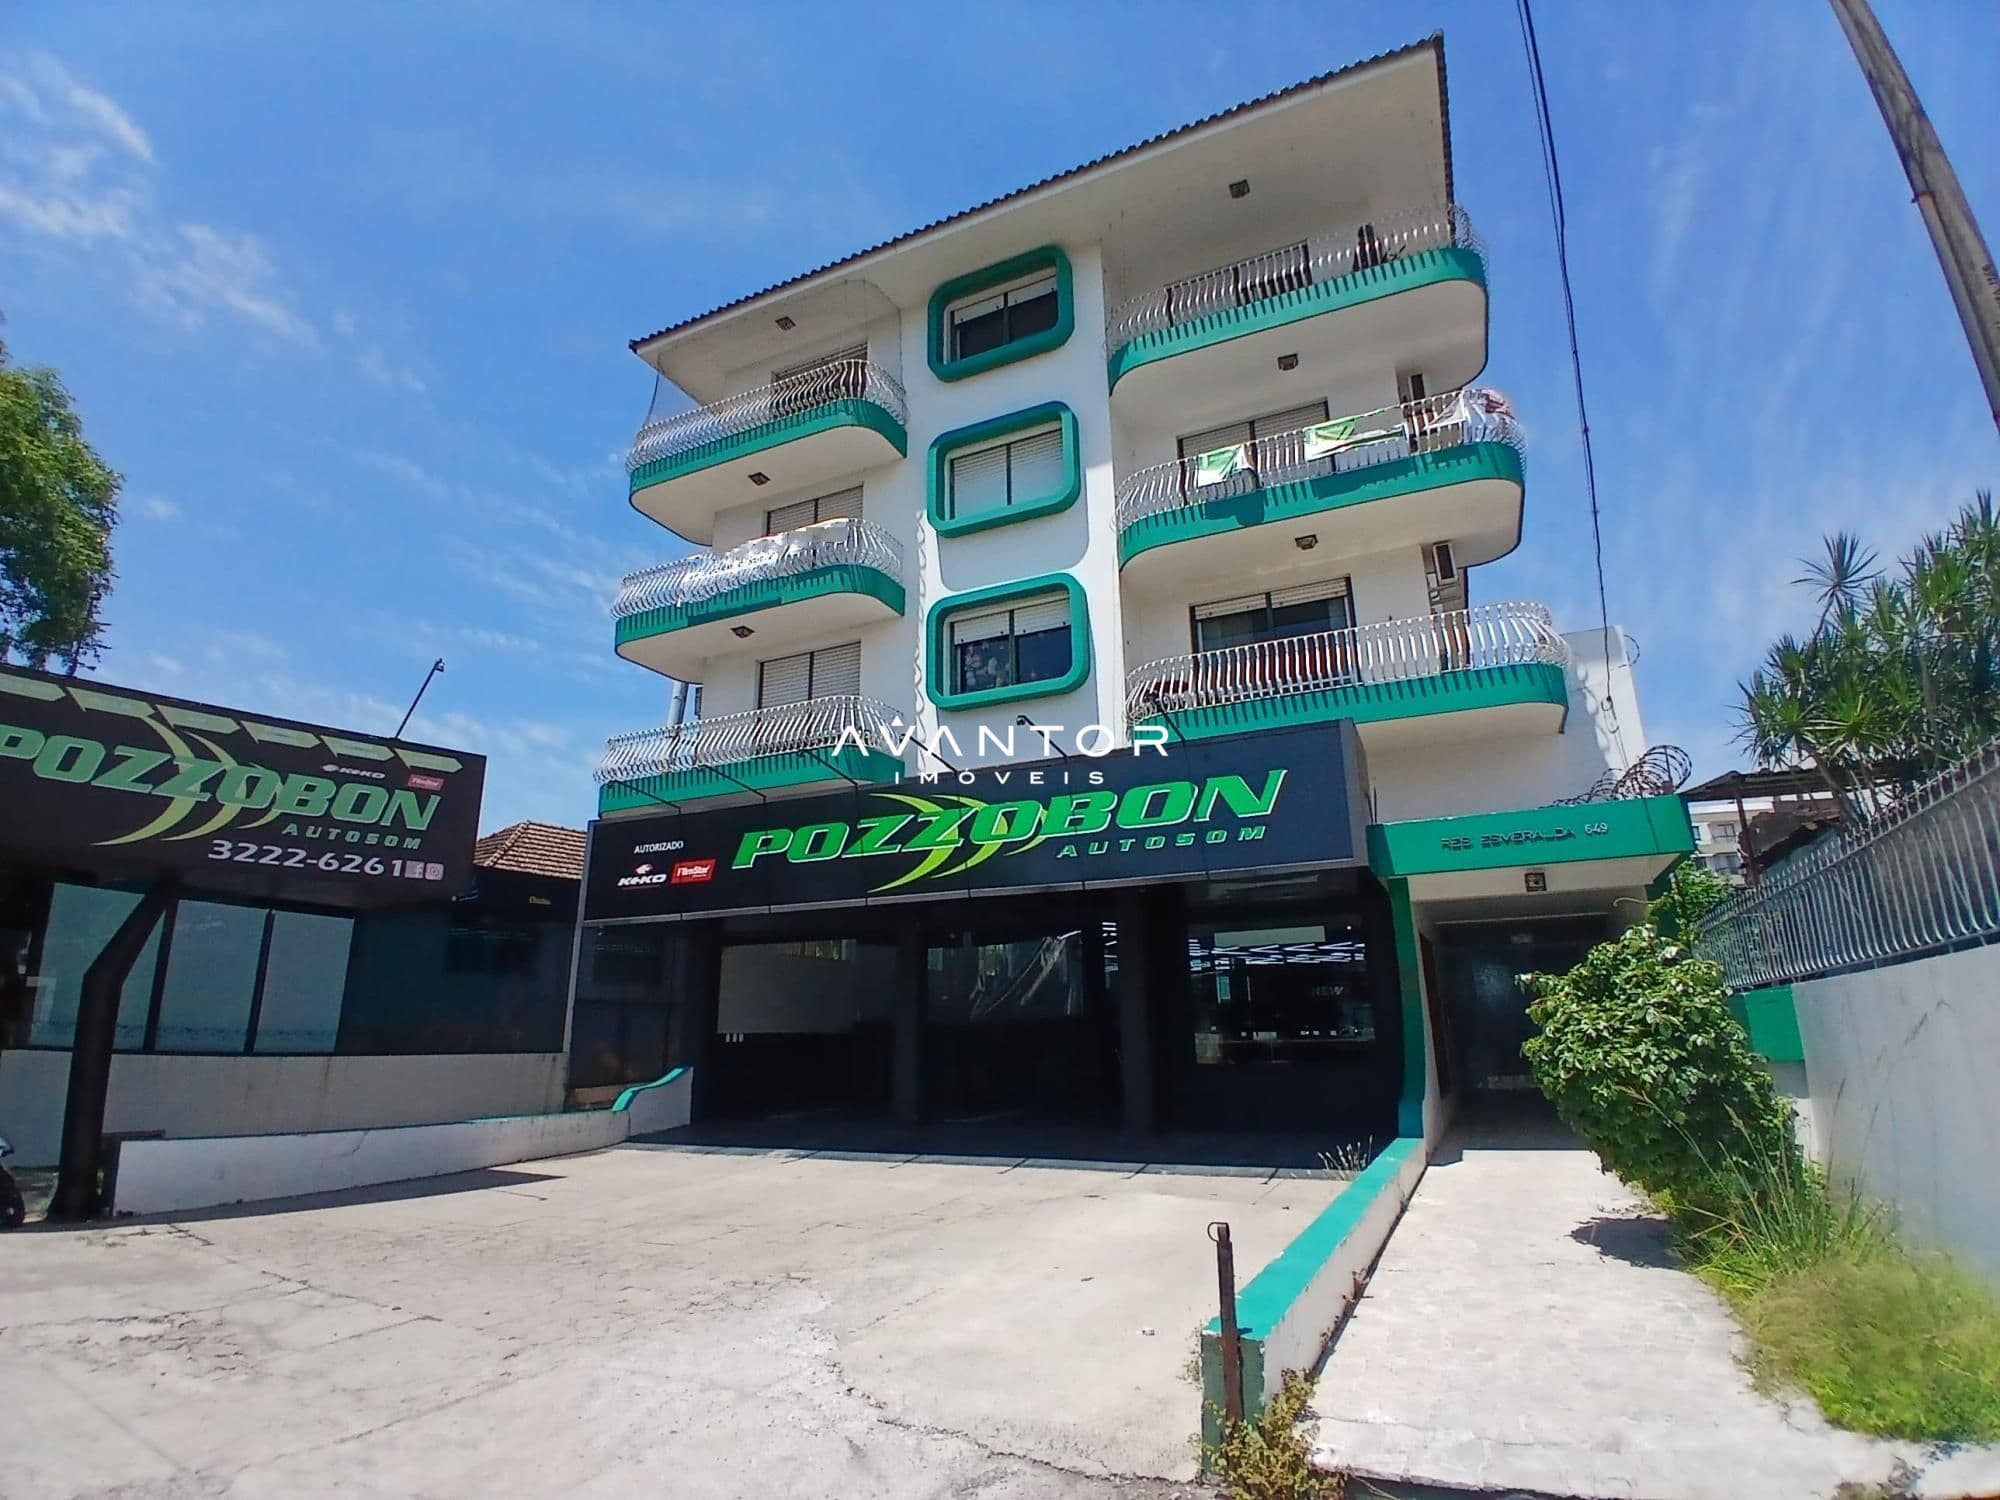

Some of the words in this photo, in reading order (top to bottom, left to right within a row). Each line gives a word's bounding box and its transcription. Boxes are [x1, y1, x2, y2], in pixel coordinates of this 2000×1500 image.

[731, 769, 1288, 869] POZZOBON
[1584, 822, 1609, 836] 649
[281, 823, 421, 850] AUTOSOM
[634, 841, 684, 854] AUTORIZADO
[1057, 825, 1266, 858] AUTOSOM
[207, 839, 403, 877] 3222-6261
